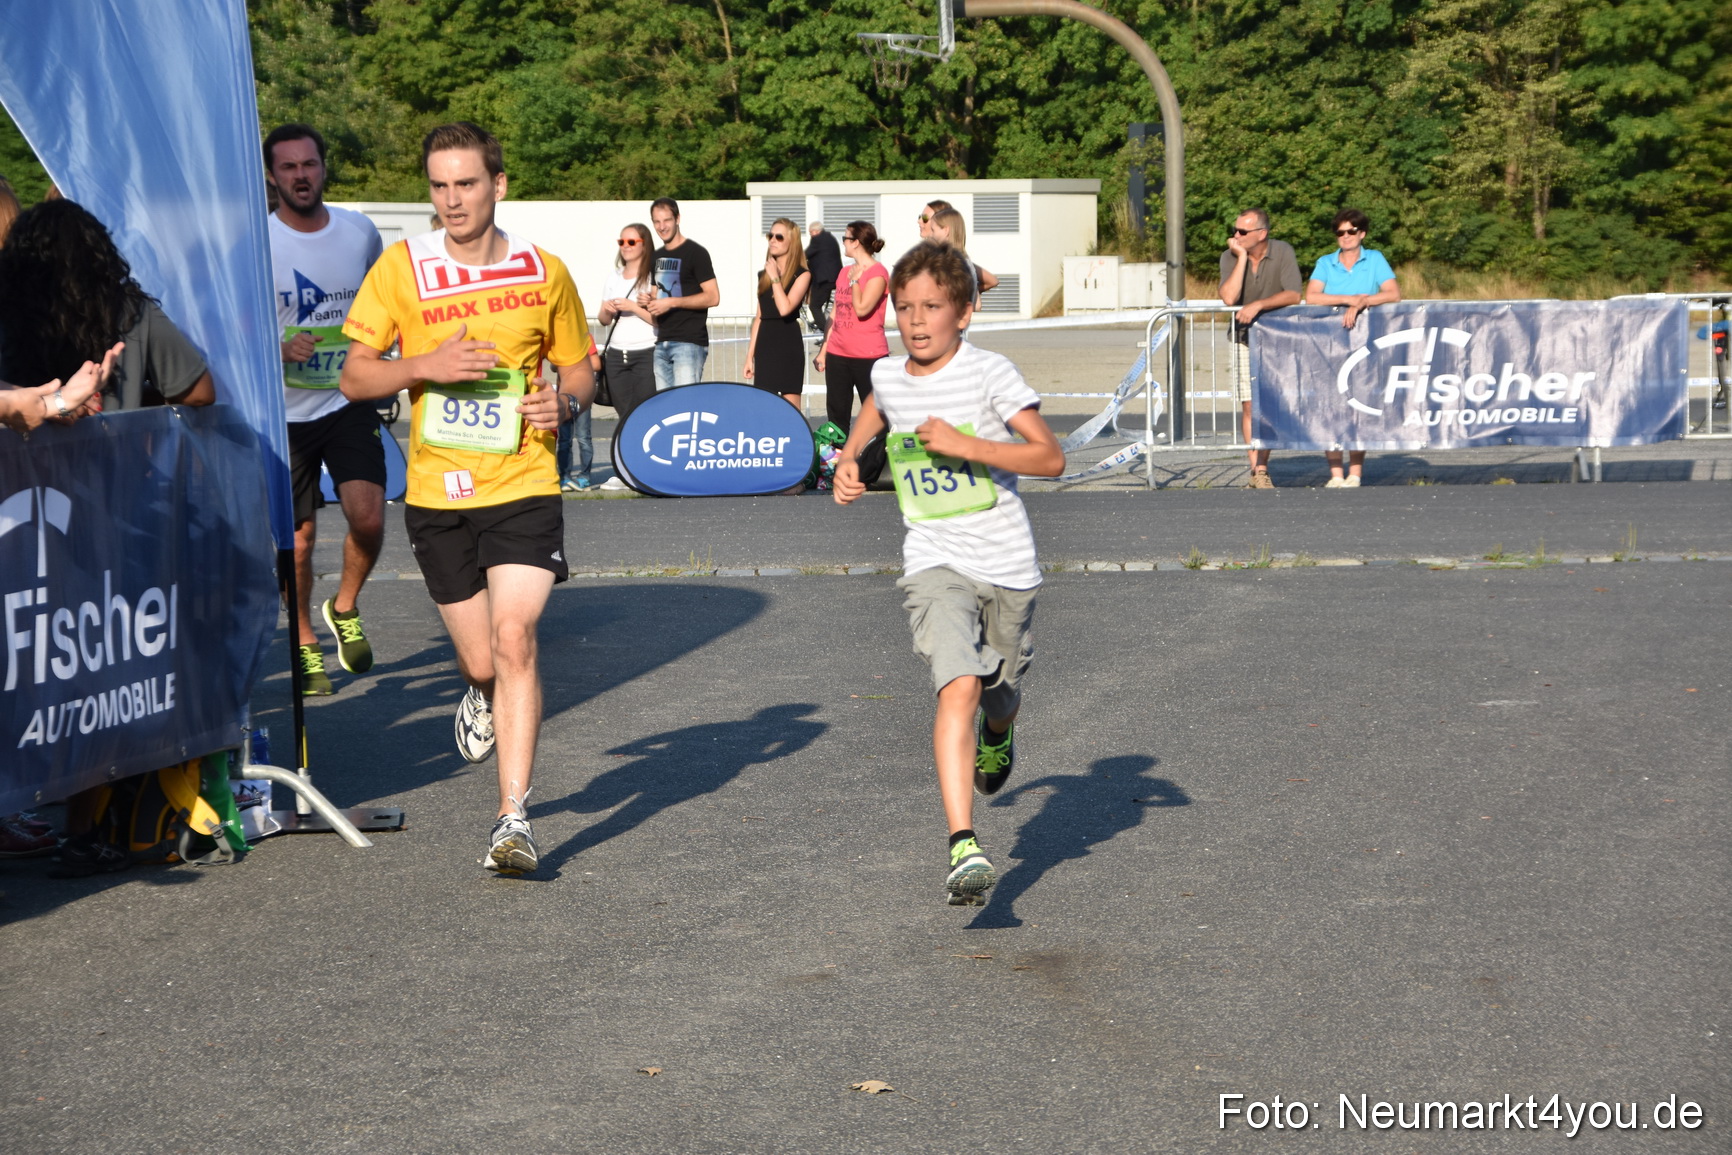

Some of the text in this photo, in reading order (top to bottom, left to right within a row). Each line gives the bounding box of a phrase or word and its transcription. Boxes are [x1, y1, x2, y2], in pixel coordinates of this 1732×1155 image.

[656, 259, 679, 271] PUMA
[309, 308, 343, 323] Team
[421, 289, 547, 326] MAX BÖGL
[1383, 362, 1596, 404] Fischer
[442, 397, 501, 429] 935
[1402, 407, 1578, 427] AUTOMOBILE
[671, 431, 790, 458] Fischer
[684, 457, 784, 470] AUTOMOBILE
[903, 461, 977, 496] 1531
[17, 672, 176, 749] AUTOMOBILE
